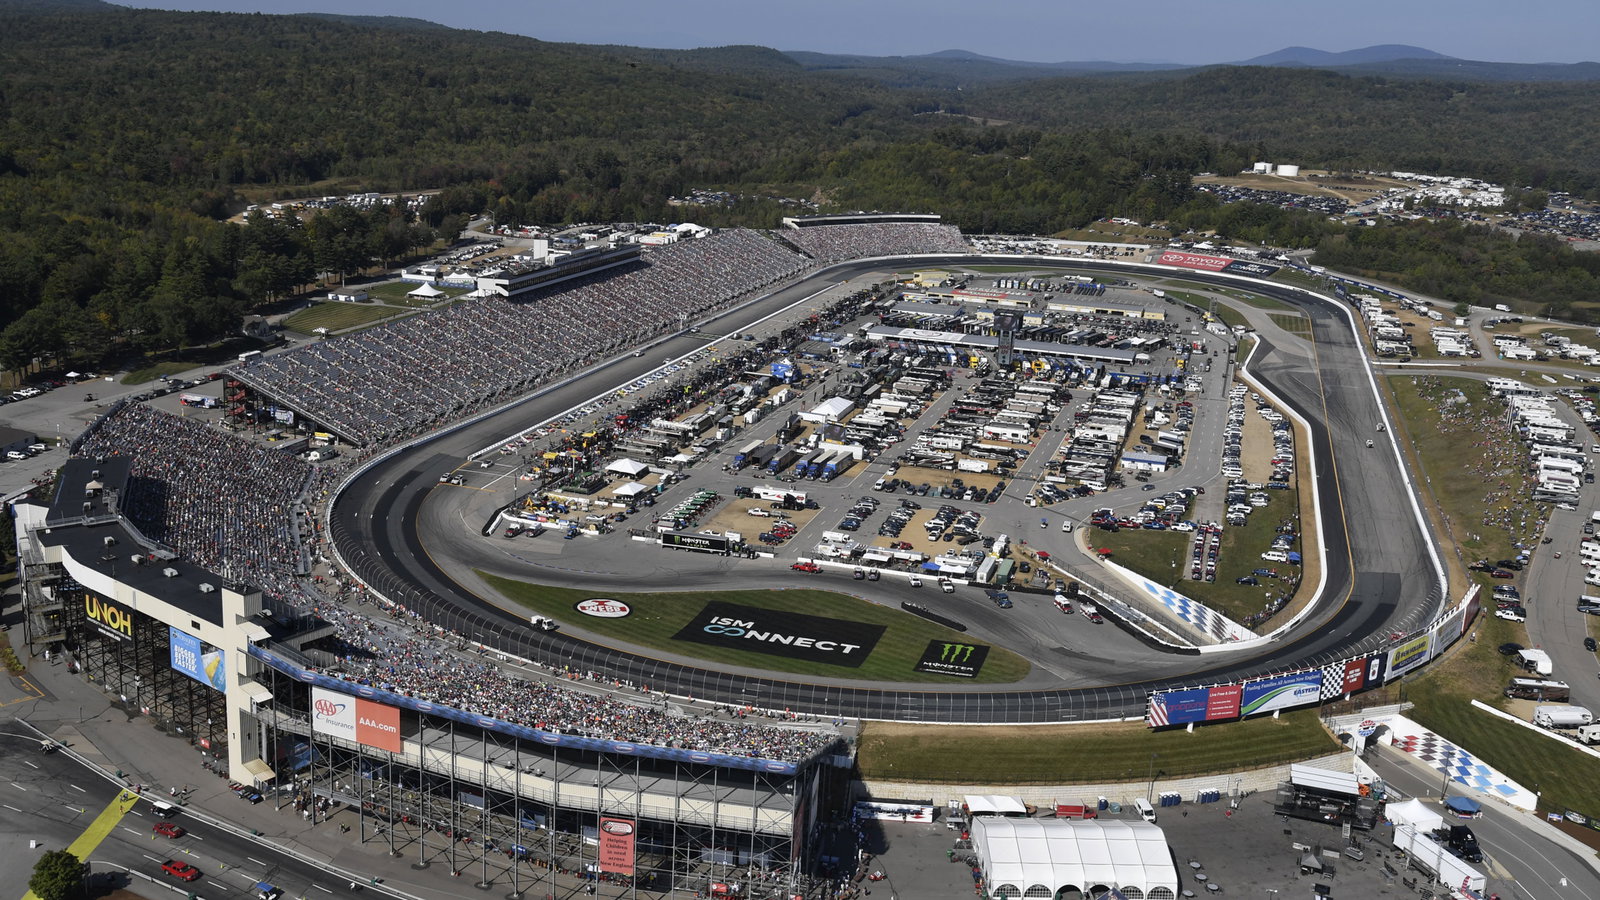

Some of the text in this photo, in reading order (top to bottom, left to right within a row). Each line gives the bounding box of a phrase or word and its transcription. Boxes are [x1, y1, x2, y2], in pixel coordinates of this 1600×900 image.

[1186, 256, 1226, 266] TOYOTA
[682, 537, 710, 546] MONSTER
[85, 593, 132, 636] UNOH
[710, 616, 755, 629] ISM
[703, 624, 861, 654] CONNECT
[923, 662, 974, 671] MONSTER
[317, 700, 334, 716] AAA
[326, 718, 354, 730] Insurance
[359, 717, 397, 733] AAA.com
